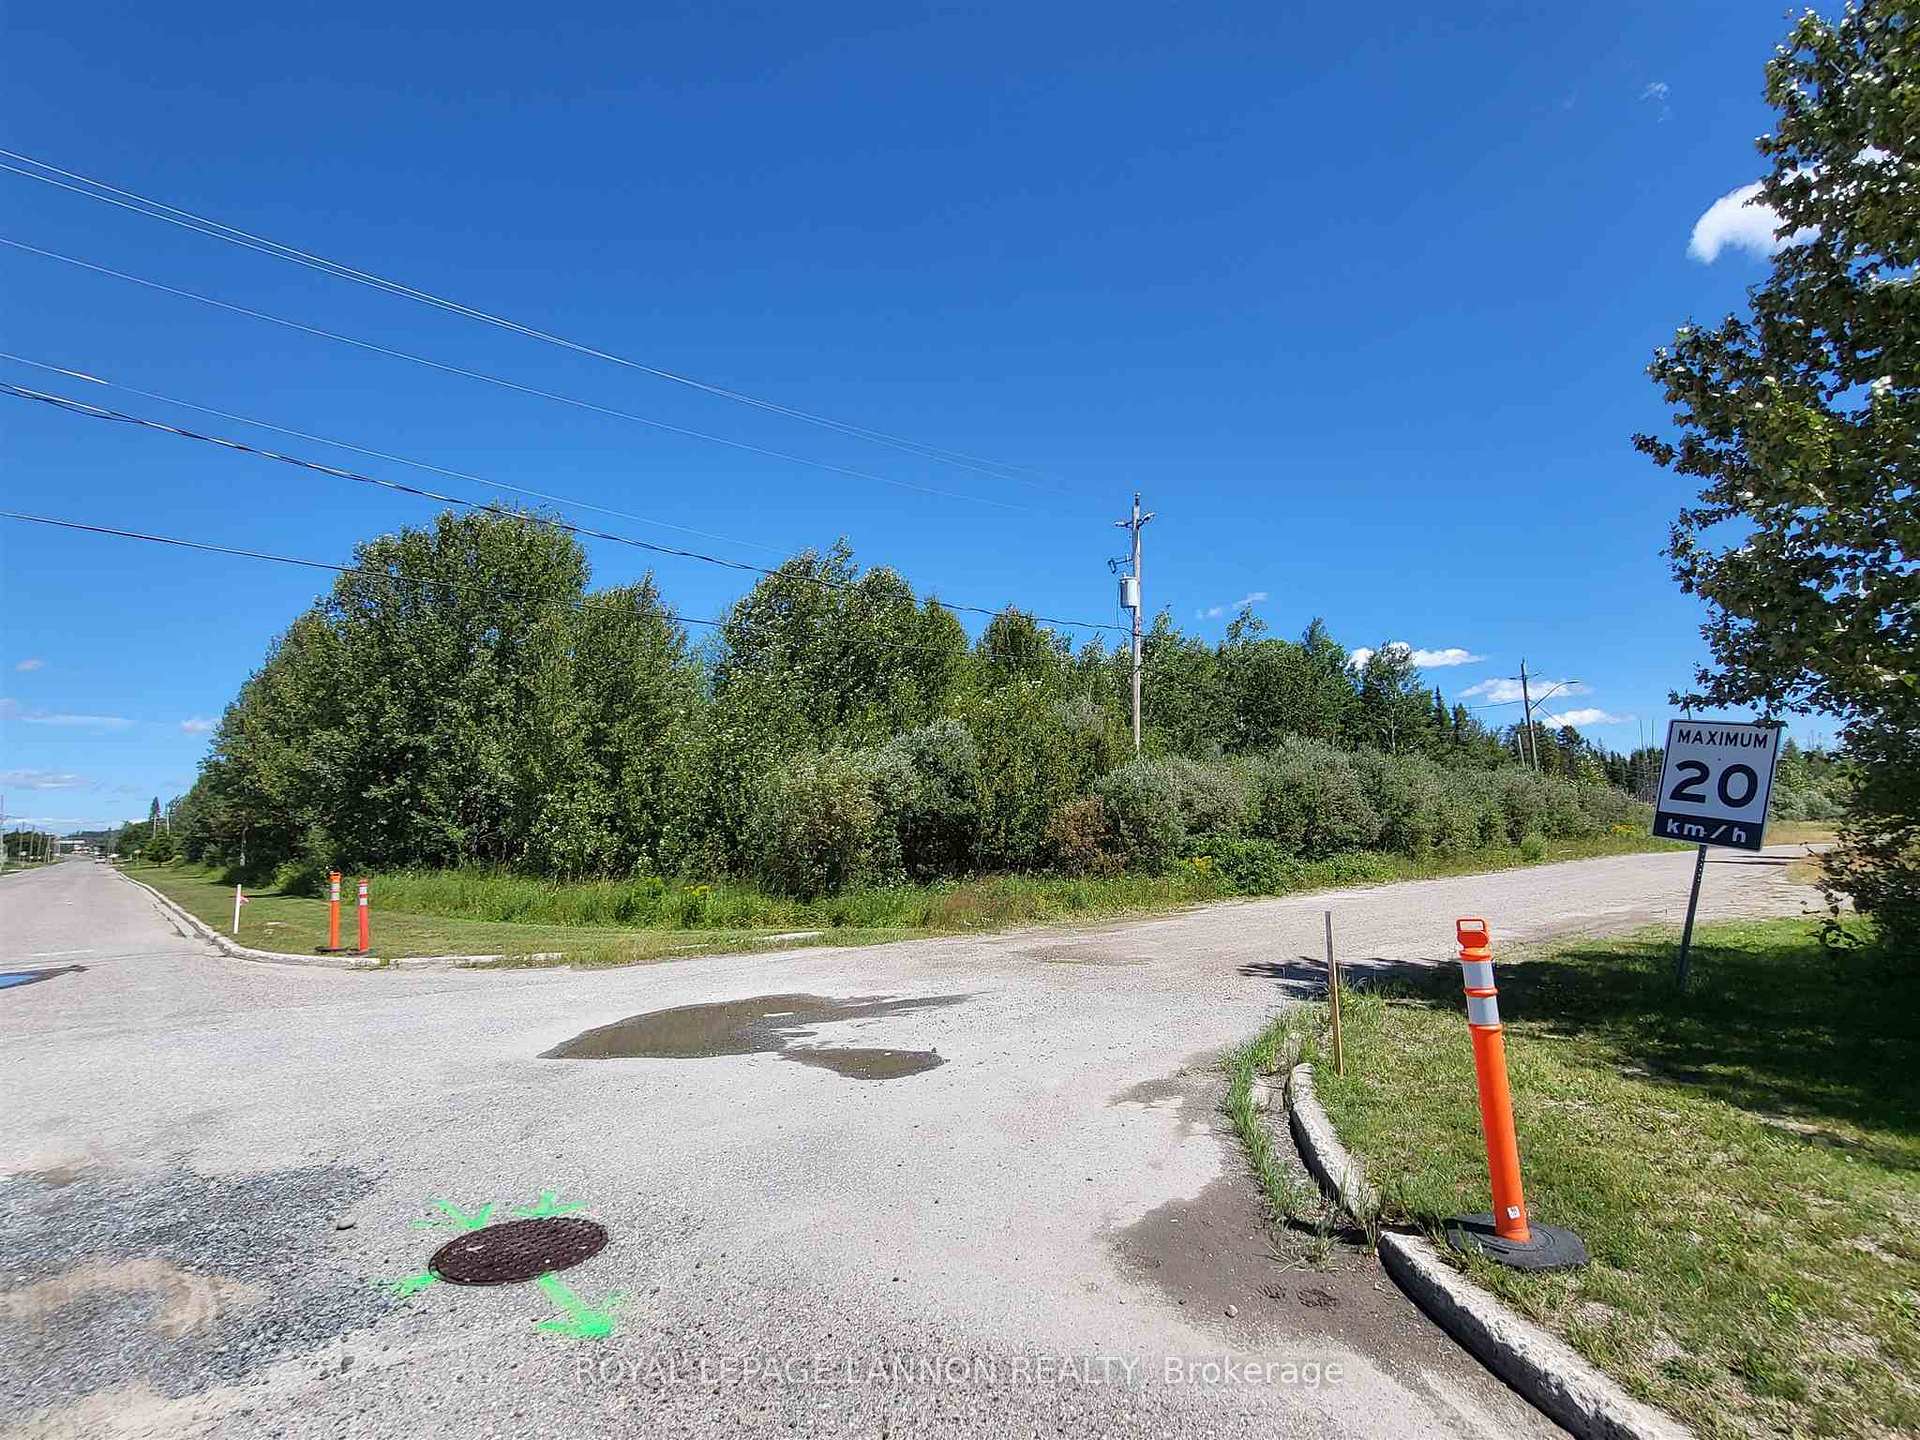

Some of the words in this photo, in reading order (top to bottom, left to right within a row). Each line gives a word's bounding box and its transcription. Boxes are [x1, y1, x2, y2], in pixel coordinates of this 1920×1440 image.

[1677, 728, 1769, 749] MAXIMUM
[1669, 760, 1758, 808] 20
[1666, 818, 1747, 843] km/h
